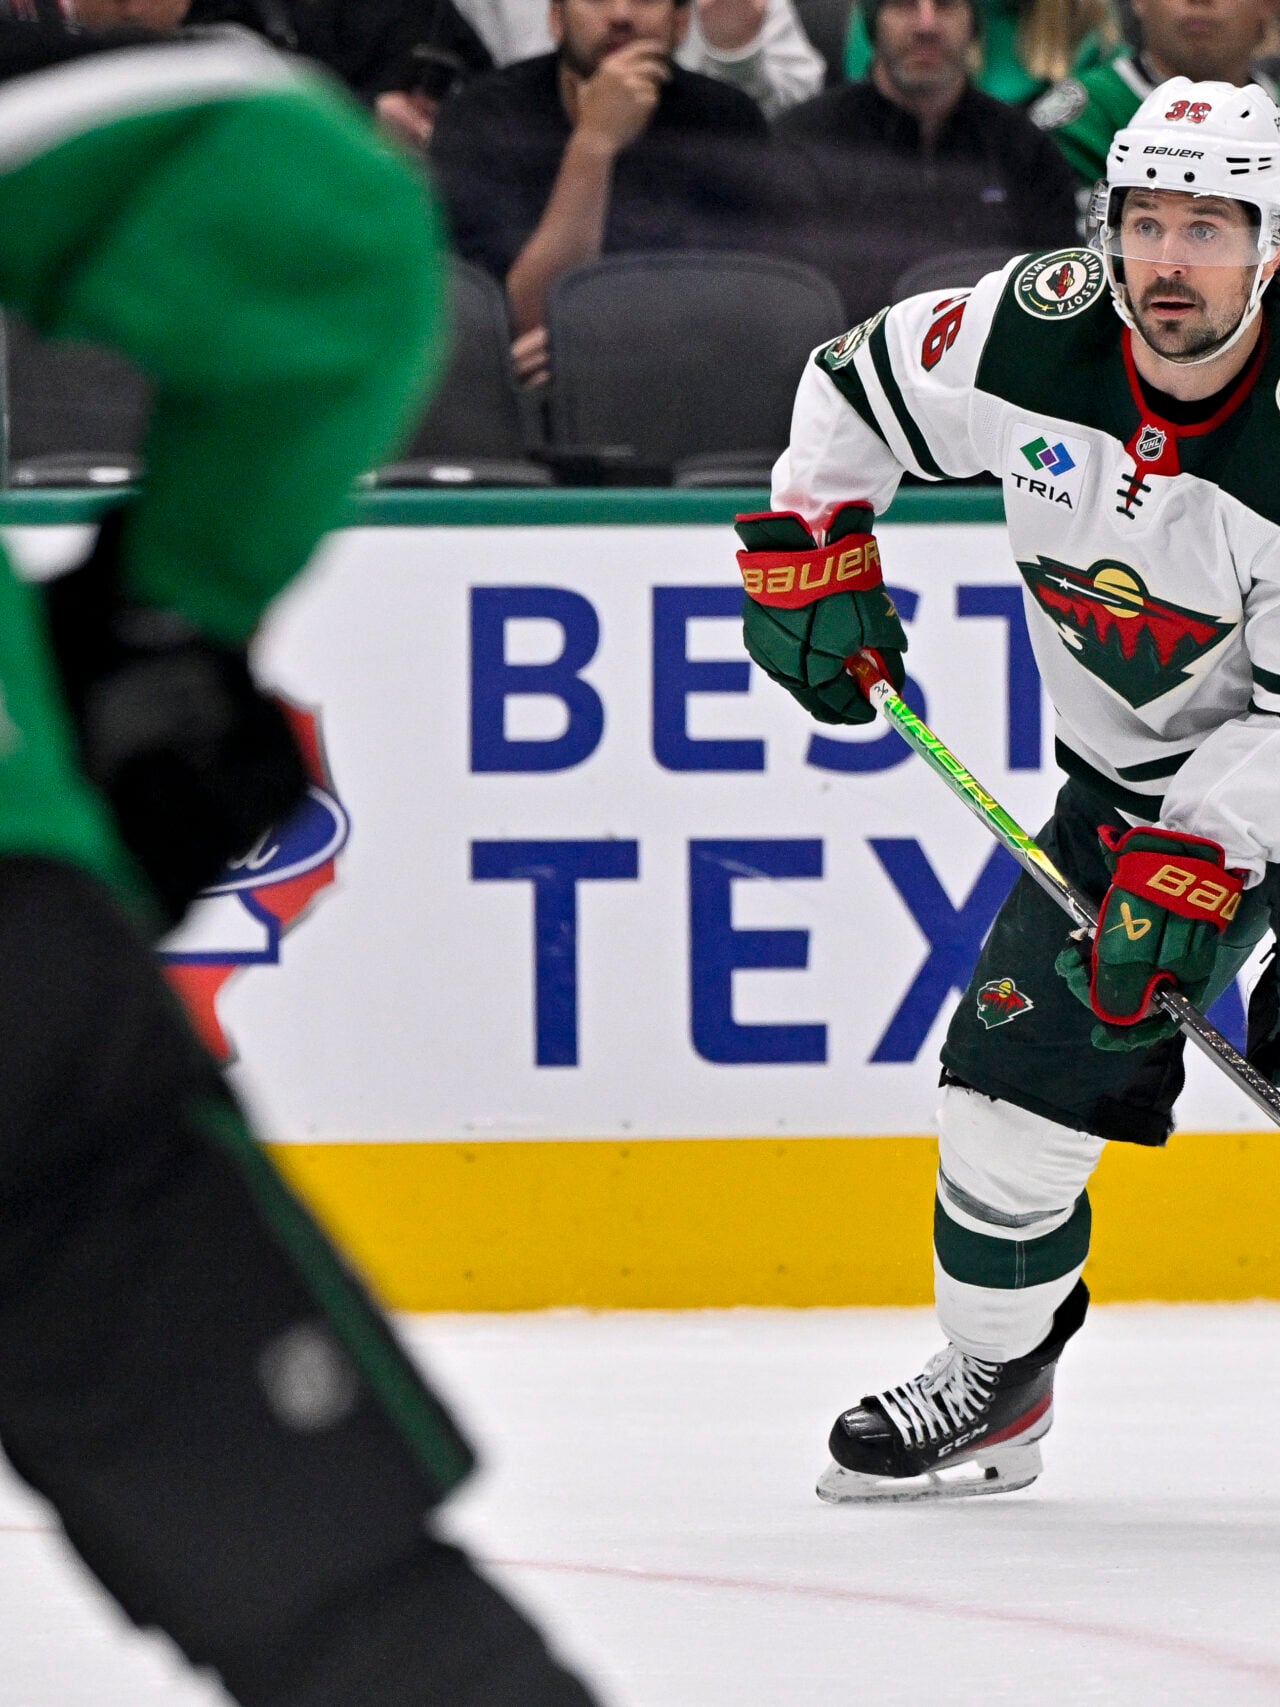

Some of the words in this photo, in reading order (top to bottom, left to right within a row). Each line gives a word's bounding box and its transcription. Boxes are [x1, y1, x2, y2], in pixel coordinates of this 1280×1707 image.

[1165, 100, 1212, 124] 36
[1143, 146, 1204, 160] BAUER
[1022, 263, 1047, 291] WILD
[1057, 253, 1100, 313] MINNESOTA
[921, 293, 971, 372] 6
[1011, 472, 1073, 509] TRIA
[743, 541, 881, 594] BAUER
[470, 838, 1248, 1067] TEX
[938, 1424, 988, 1457] CCM
